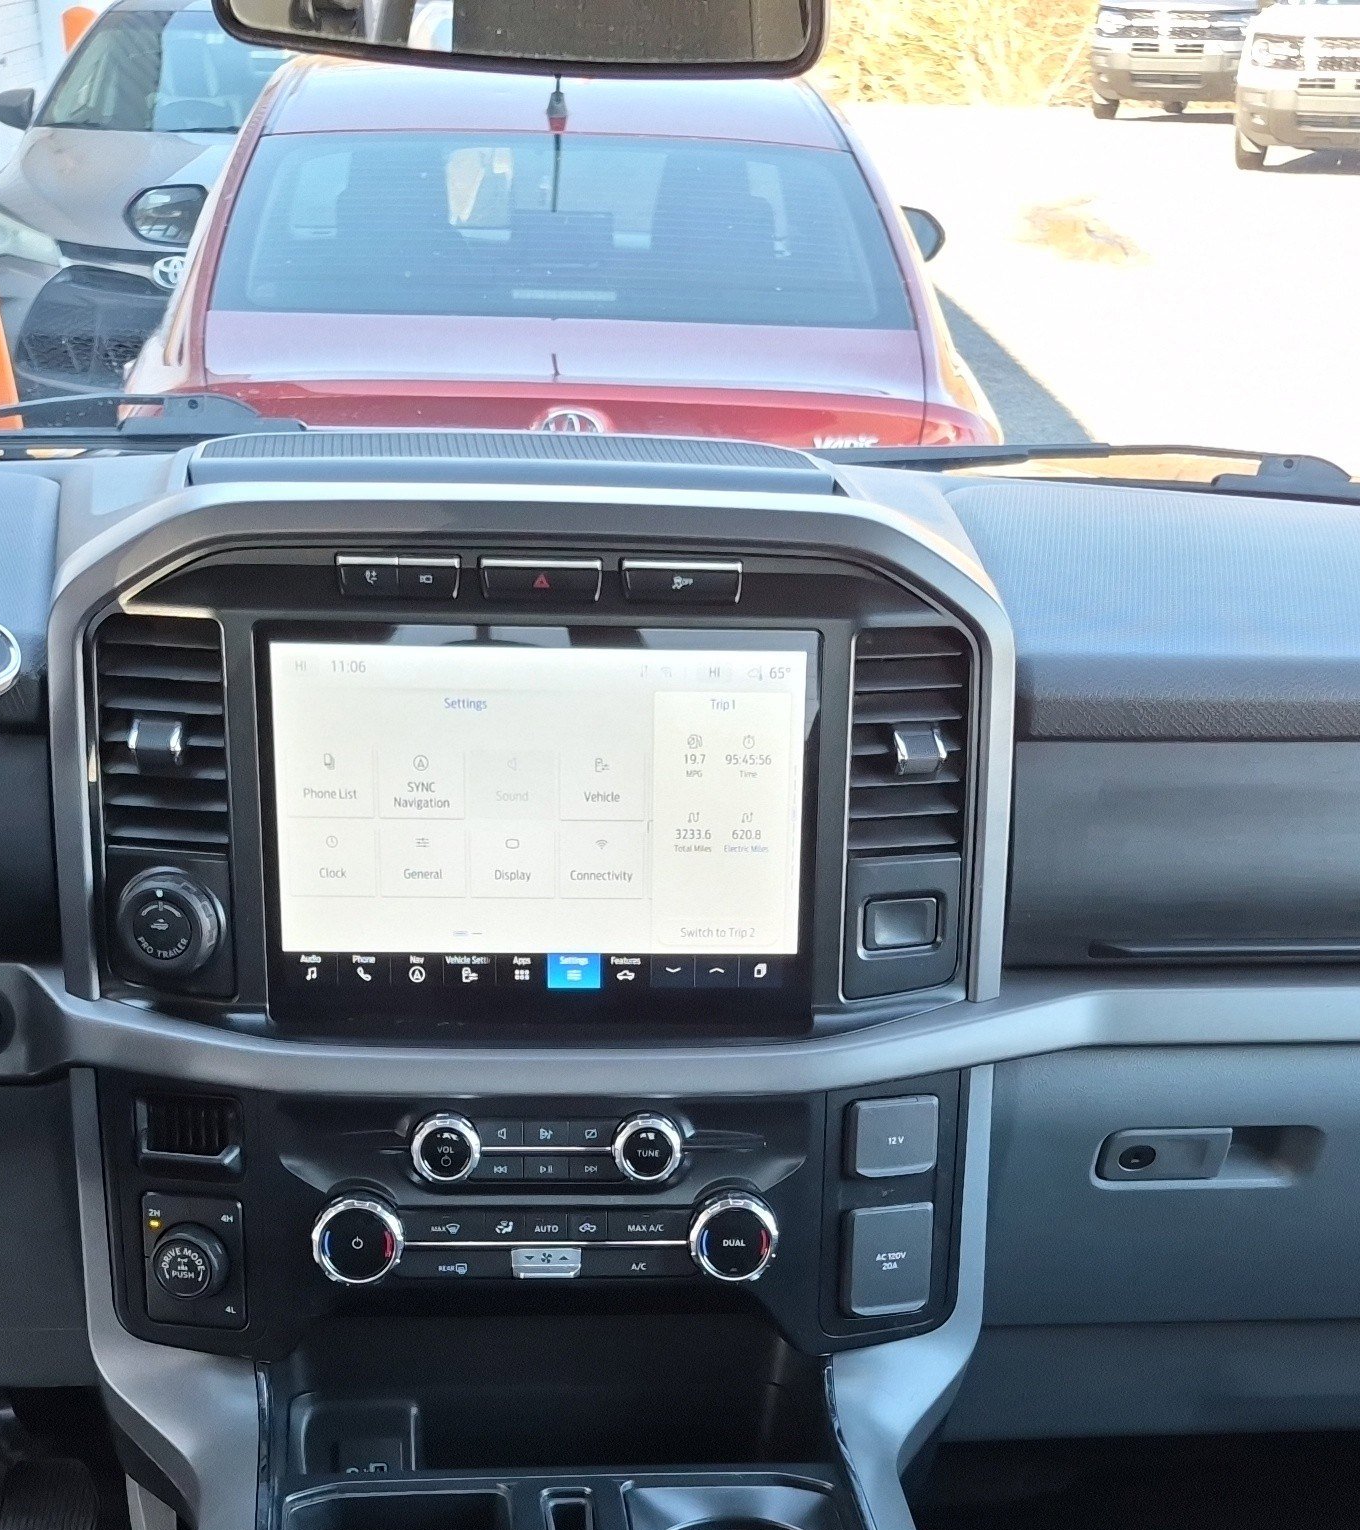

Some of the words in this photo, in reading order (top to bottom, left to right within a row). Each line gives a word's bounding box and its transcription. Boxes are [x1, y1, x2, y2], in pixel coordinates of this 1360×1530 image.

[294, 661, 307, 672] HI
[331, 660, 366, 673] 11:06
[709, 667, 721, 678] HI
[769, 667, 791, 679] 65°
[444, 698, 487, 711] Settings
[711, 700, 729, 711] Trip
[684, 754, 706, 765] 19.7
[725, 754, 772, 765] 95:45:56
[686, 770, 702, 778] MPG
[739, 770, 758, 778] Time
[407, 782, 435, 793] SYNC
[303, 788, 337, 800] Phone
[339, 788, 357, 800] List
[496, 790, 529, 802] Sound
[584, 791, 620, 803] Vehicle
[393, 796, 450, 810] Navigation
[675, 829, 711, 840] 3233.6
[731, 829, 761, 840] 620.8
[674, 844, 692, 853] Total
[694, 844, 712, 853] Miles
[724, 844, 749, 853] Electric
[751, 844, 768, 853] Miles
[319, 867, 347, 879] Clock
[403, 869, 443, 880] General
[494, 869, 531, 882] Display
[570, 870, 633, 882] Connectivity
[680, 927, 713, 938] Switch
[715, 928, 726, 938] to
[728, 927, 747, 940] Trip
[749, 928, 755, 938] 2
[138, 936, 154, 954] PRO
[157, 938, 188, 958] TRAILER
[300, 954, 322, 964] Audio
[352, 955, 376, 964] Phone
[409, 955, 424, 964] Nav
[445, 955, 471, 965] Vehicle
[512, 955, 531, 966] Apps
[559, 956, 588, 966] Settings
[611, 956, 641, 966] Features
[888, 1137, 897, 1145] 12
[898, 1136, 904, 1144] V
[437, 1146, 455, 1154] VOL
[637, 1150, 659, 1158] TUNE
[220, 1214, 233, 1223] 4H
[534, 1225, 558, 1233] AUTO
[627, 1224, 648, 1232] MAX
[649, 1224, 664, 1232] A/C
[722, 1239, 746, 1247] DUAL
[161, 1247, 181, 1269] DRIVE
[183, 1247, 205, 1271] MODE
[876, 1253, 886, 1262] AC
[887, 1252, 907, 1261] 120V
[631, 1262, 646, 1271] A/C
[172, 1270, 195, 1279] PUSH
[225, 1306, 236, 1314] 4L
